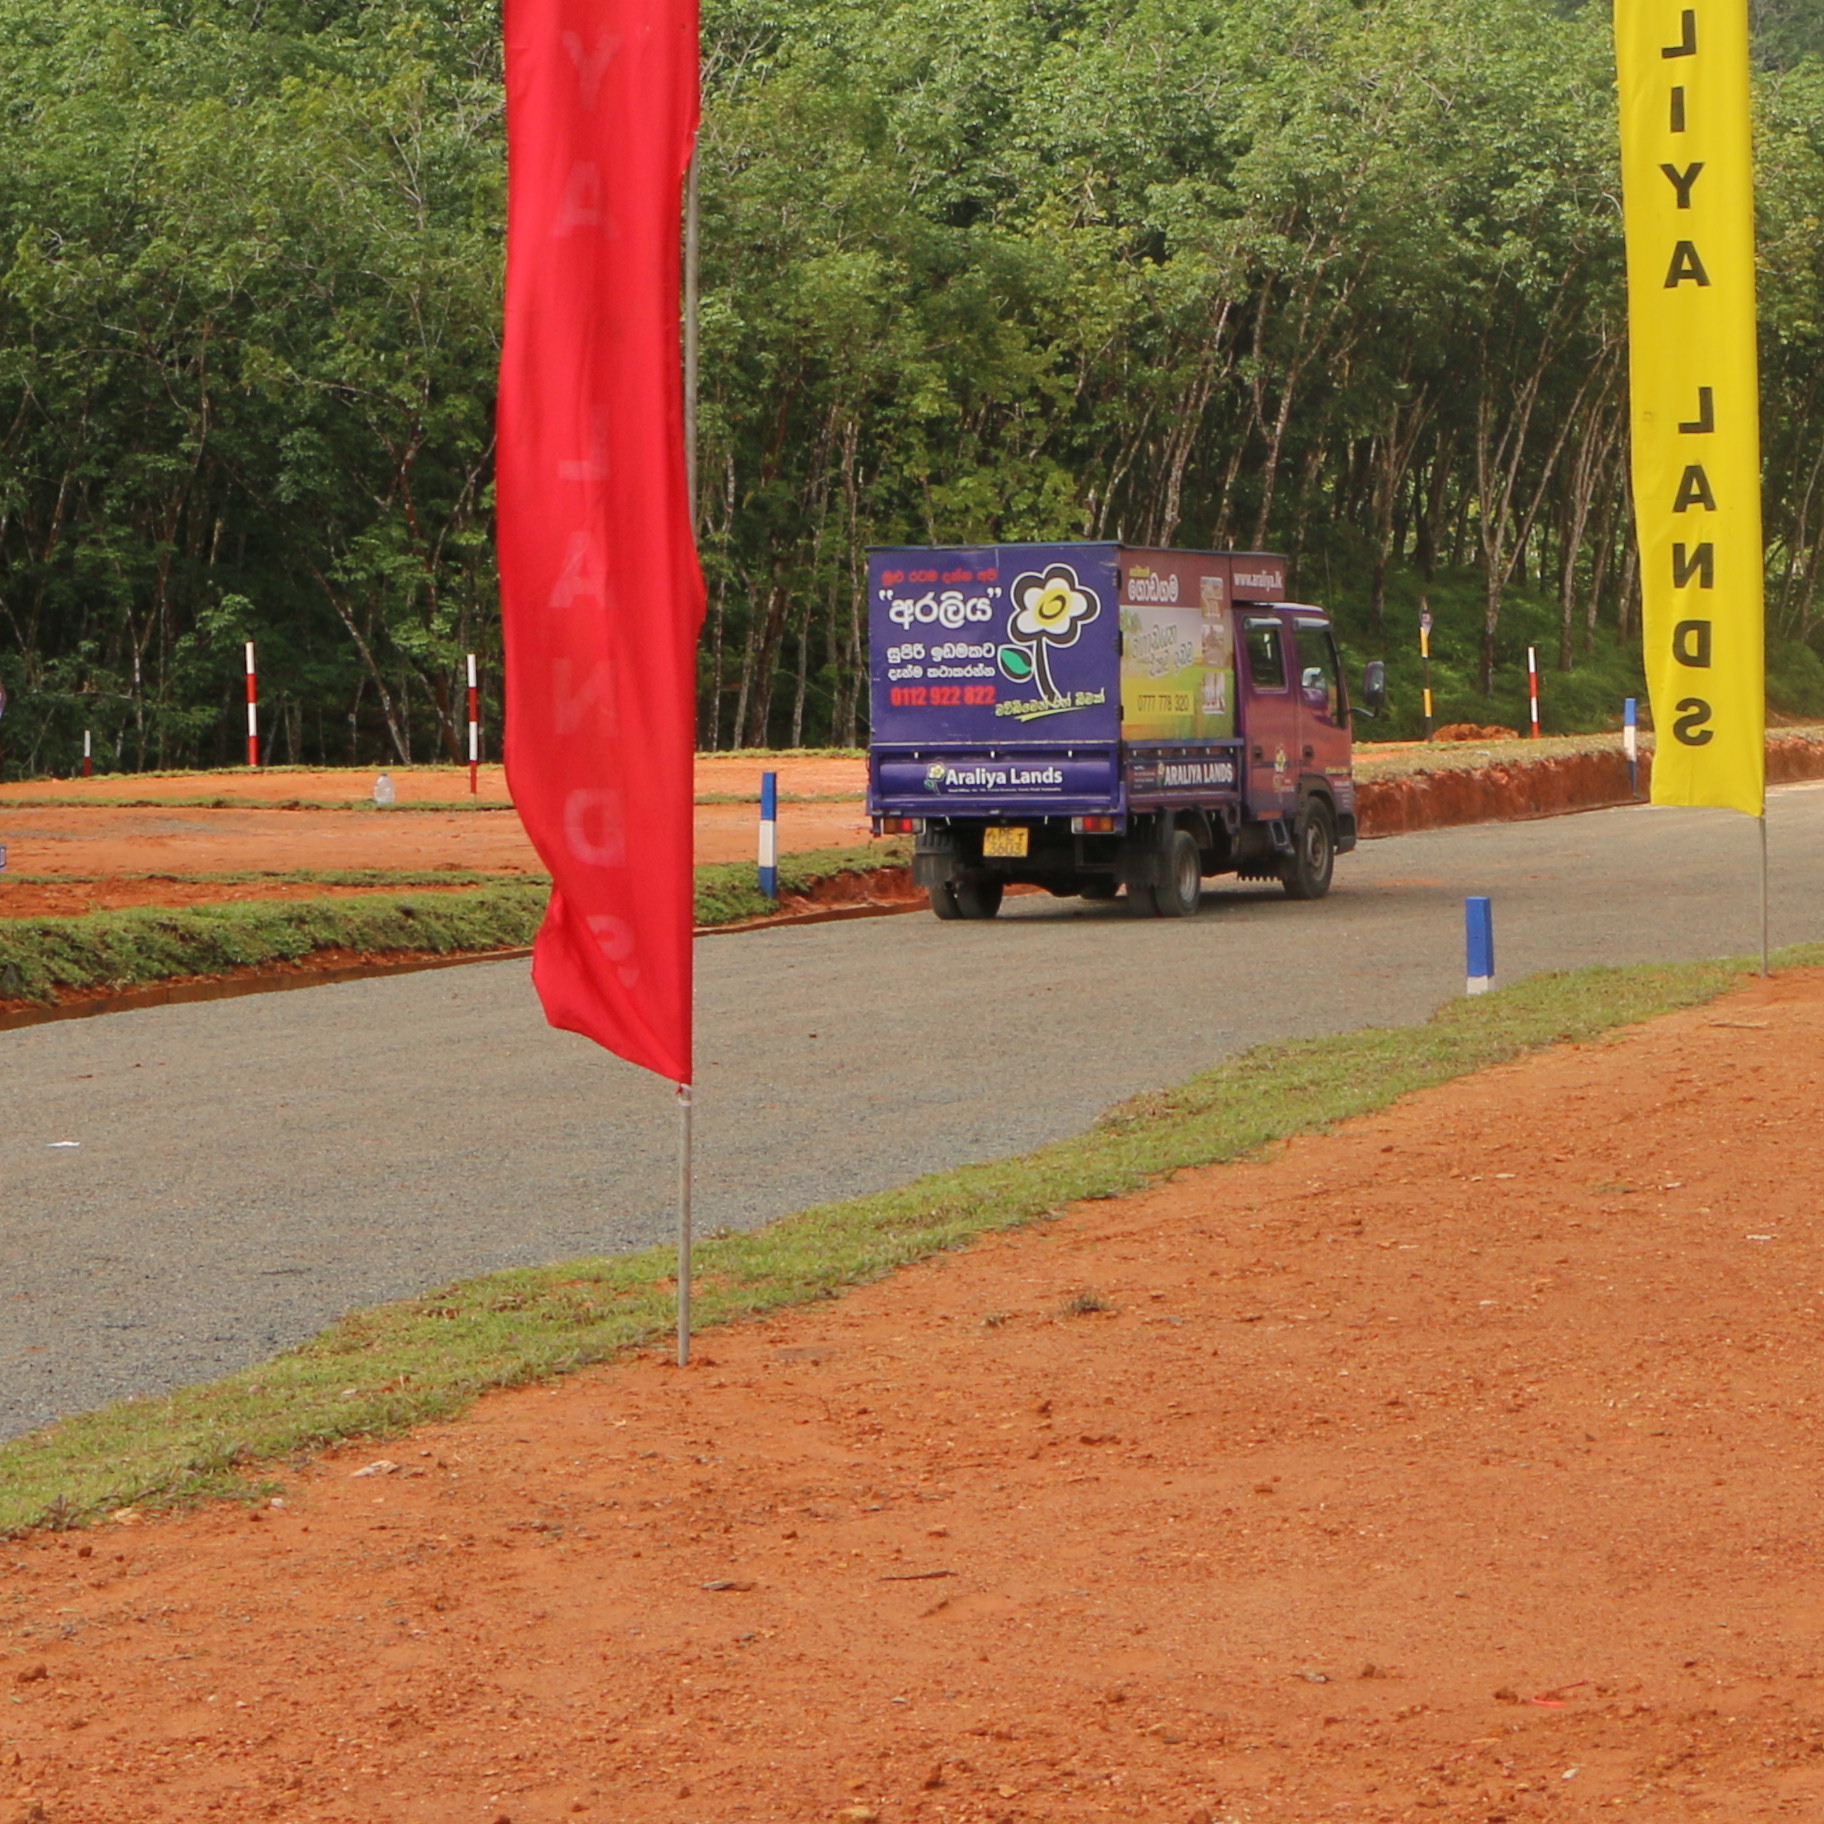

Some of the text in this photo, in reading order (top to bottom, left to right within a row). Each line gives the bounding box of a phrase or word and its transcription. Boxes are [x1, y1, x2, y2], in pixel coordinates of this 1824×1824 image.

[890, 686, 927, 706] 0112
[930, 686, 961, 706] 922
[945, 767, 1063, 789] Araliya Lands
[1164, 764, 1202, 786] ARALIYA
[1203, 763, 1233, 784] LANDS
